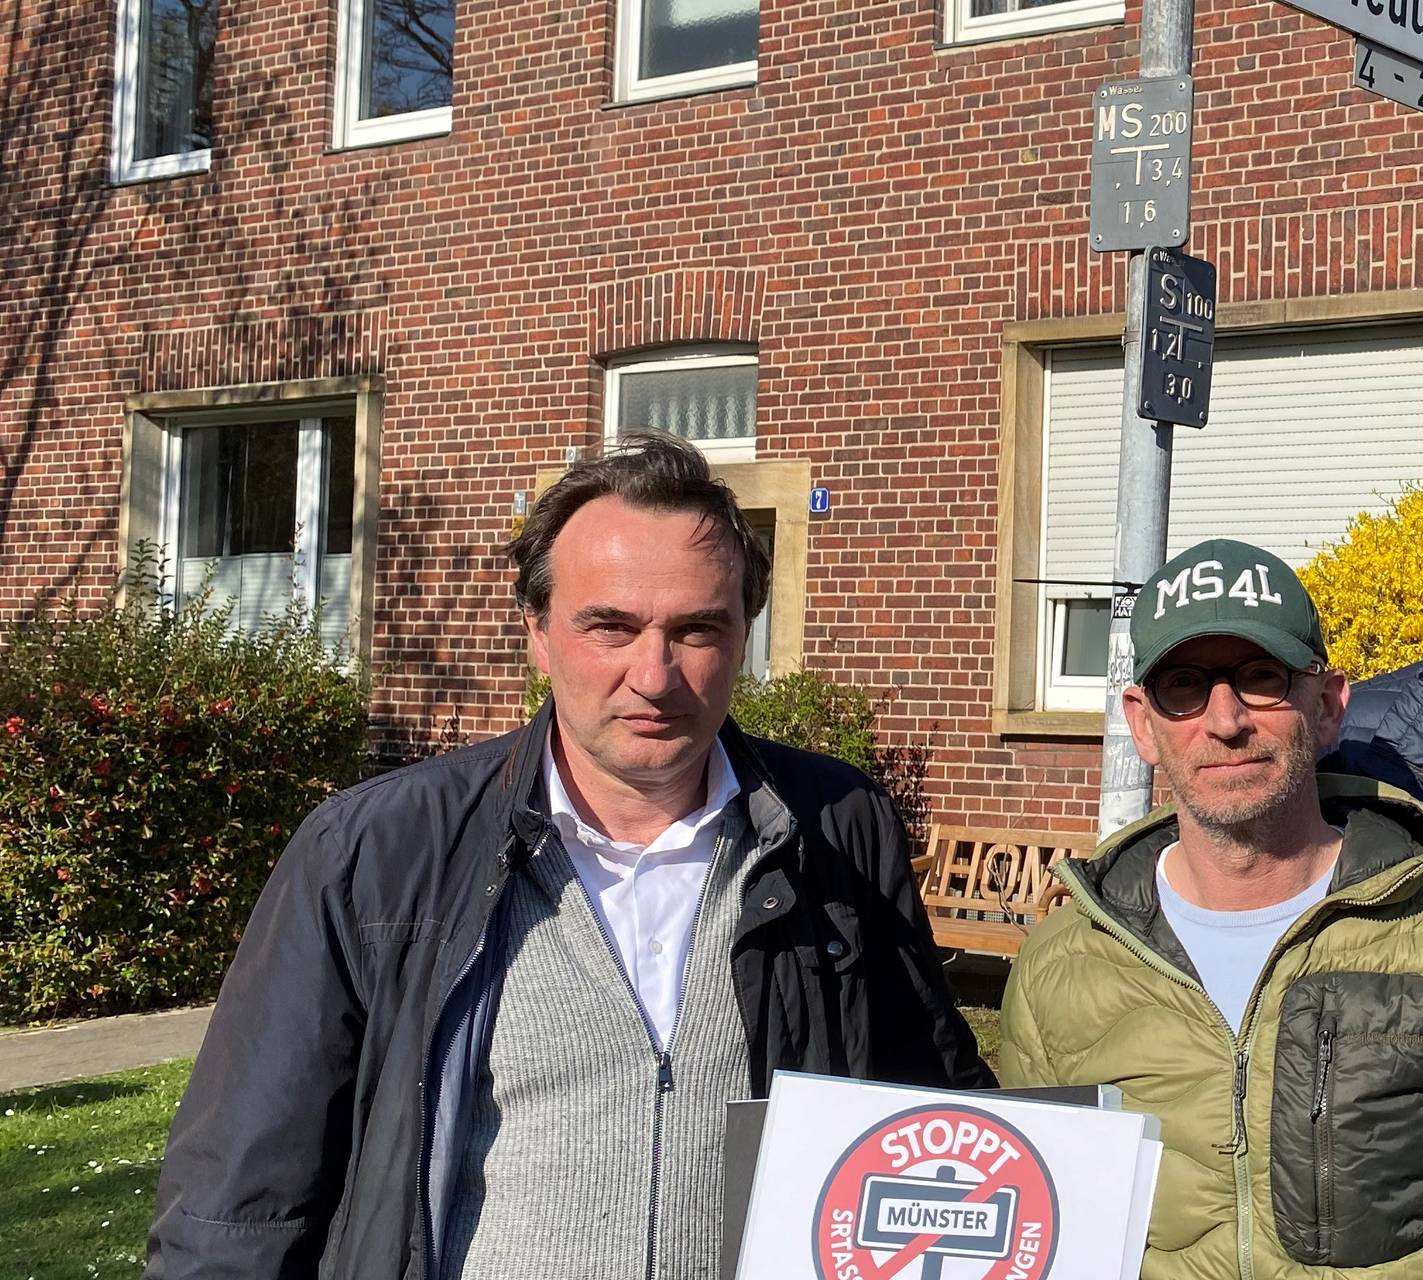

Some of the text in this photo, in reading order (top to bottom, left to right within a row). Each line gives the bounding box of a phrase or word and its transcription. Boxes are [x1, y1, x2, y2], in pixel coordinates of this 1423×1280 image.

[1358, 49, 1375, 88] 4
[1099, 103, 1186, 141] MS 200
[1160, 274, 1177, 309] S
[816, 491, 822, 509] 7
[881, 1119, 1020, 1175] STOPPT
[887, 1203, 988, 1230] MÜNSTER
[830, 1208, 863, 1280] SRTAS
